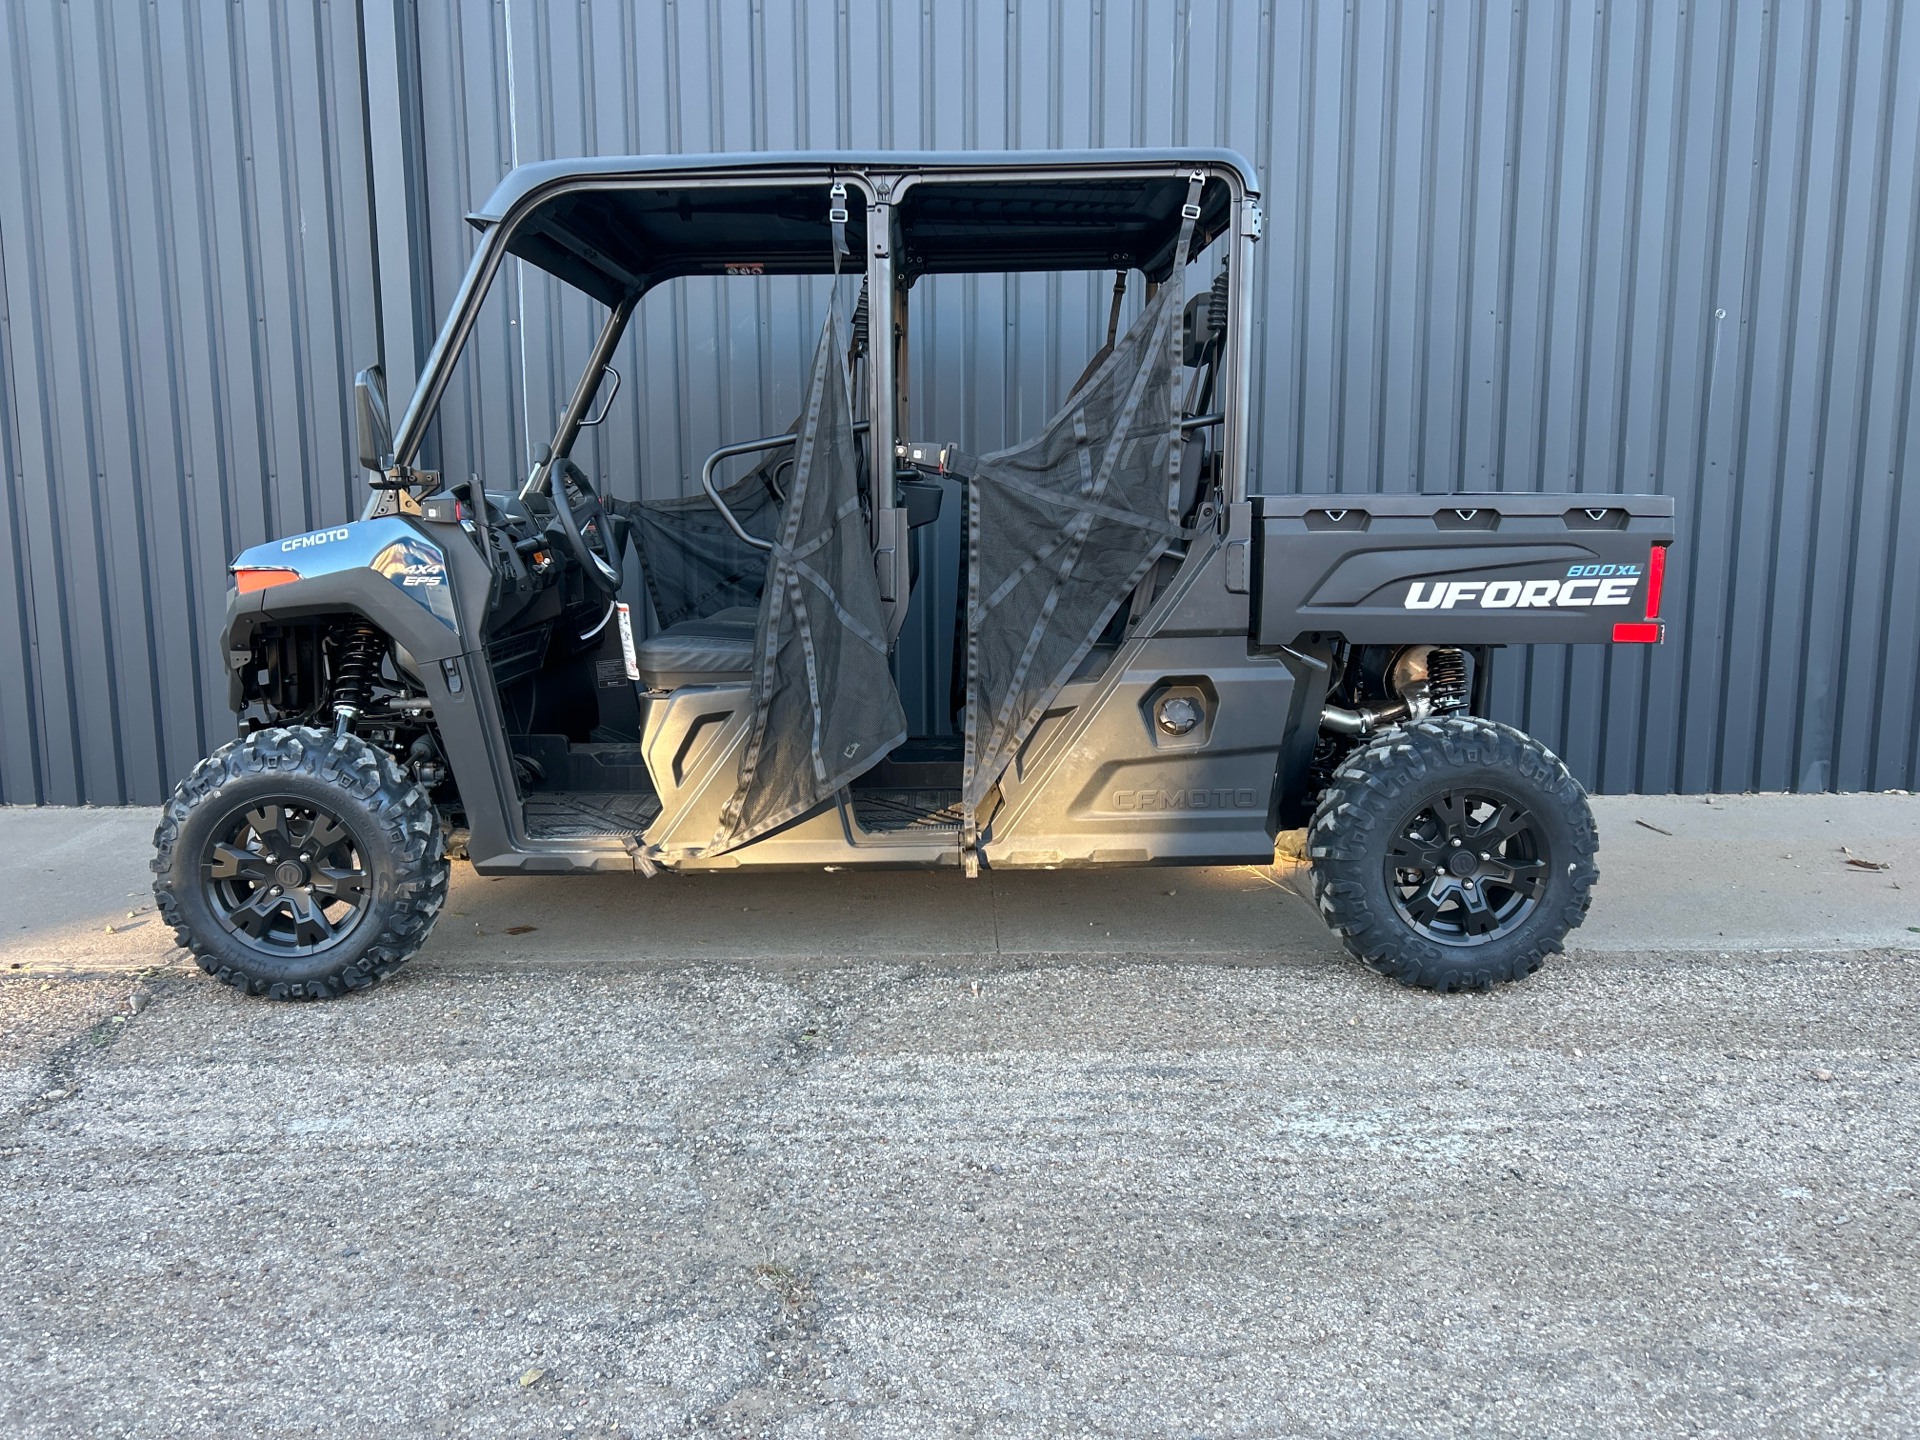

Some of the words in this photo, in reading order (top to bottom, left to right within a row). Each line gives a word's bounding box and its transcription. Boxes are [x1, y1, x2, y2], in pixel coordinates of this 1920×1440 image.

[281, 528, 349, 552] CFMOTO
[403, 564, 440, 575] 4X4
[402, 576, 442, 586] EPS
[1404, 577, 1639, 609] UFORCE
[1112, 788, 1258, 810] CFMOTO
